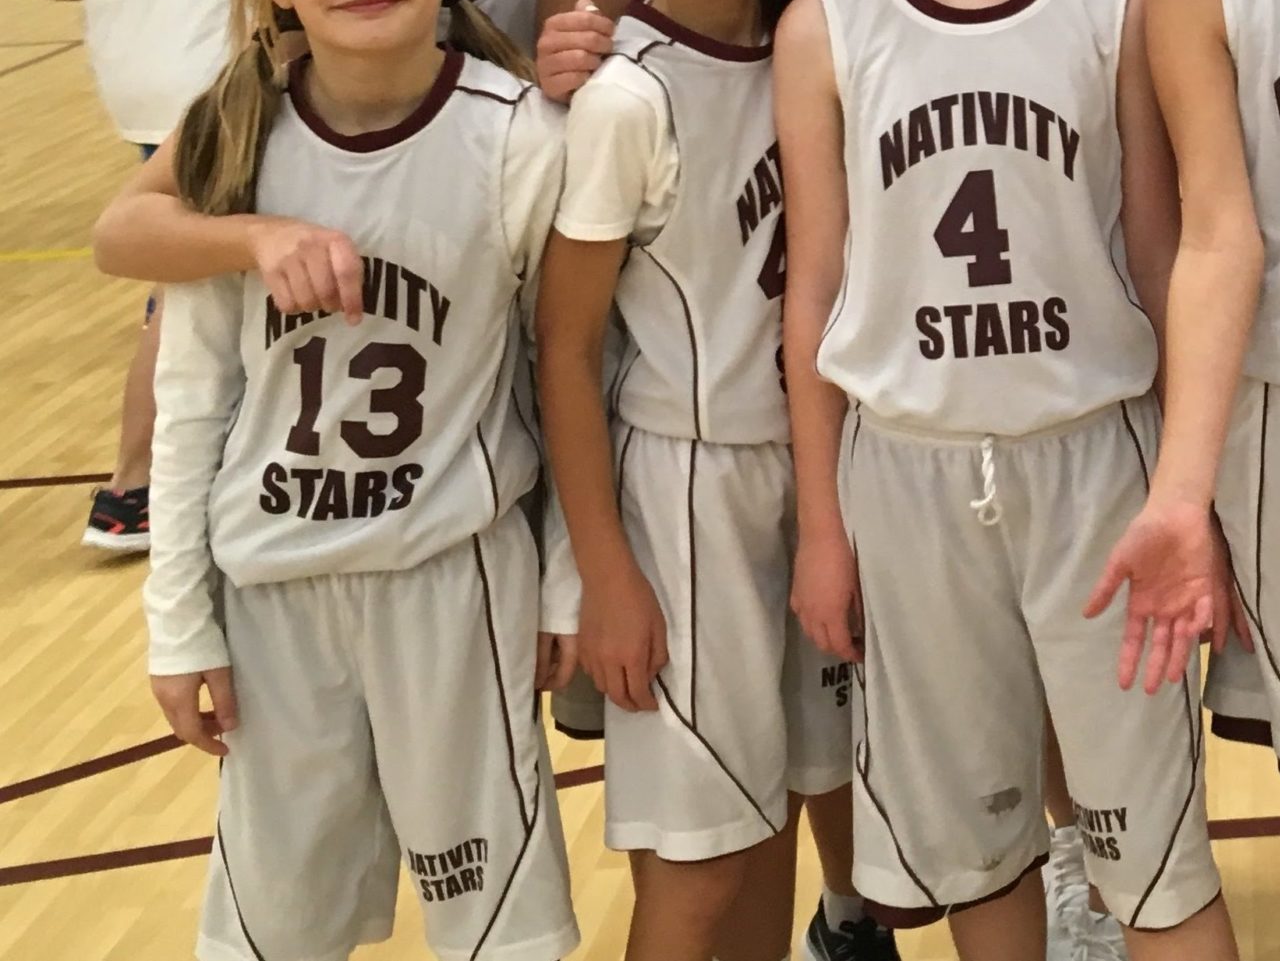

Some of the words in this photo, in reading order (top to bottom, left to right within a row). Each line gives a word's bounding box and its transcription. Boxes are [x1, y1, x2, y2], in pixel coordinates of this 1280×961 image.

[879, 90, 1081, 191] NATIVITY
[933, 169, 1012, 288] 4
[915, 296, 1070, 360] STARS
[285, 336, 427, 459] 13
[259, 461, 424, 521] STARS
[420, 865, 484, 902] STARS
